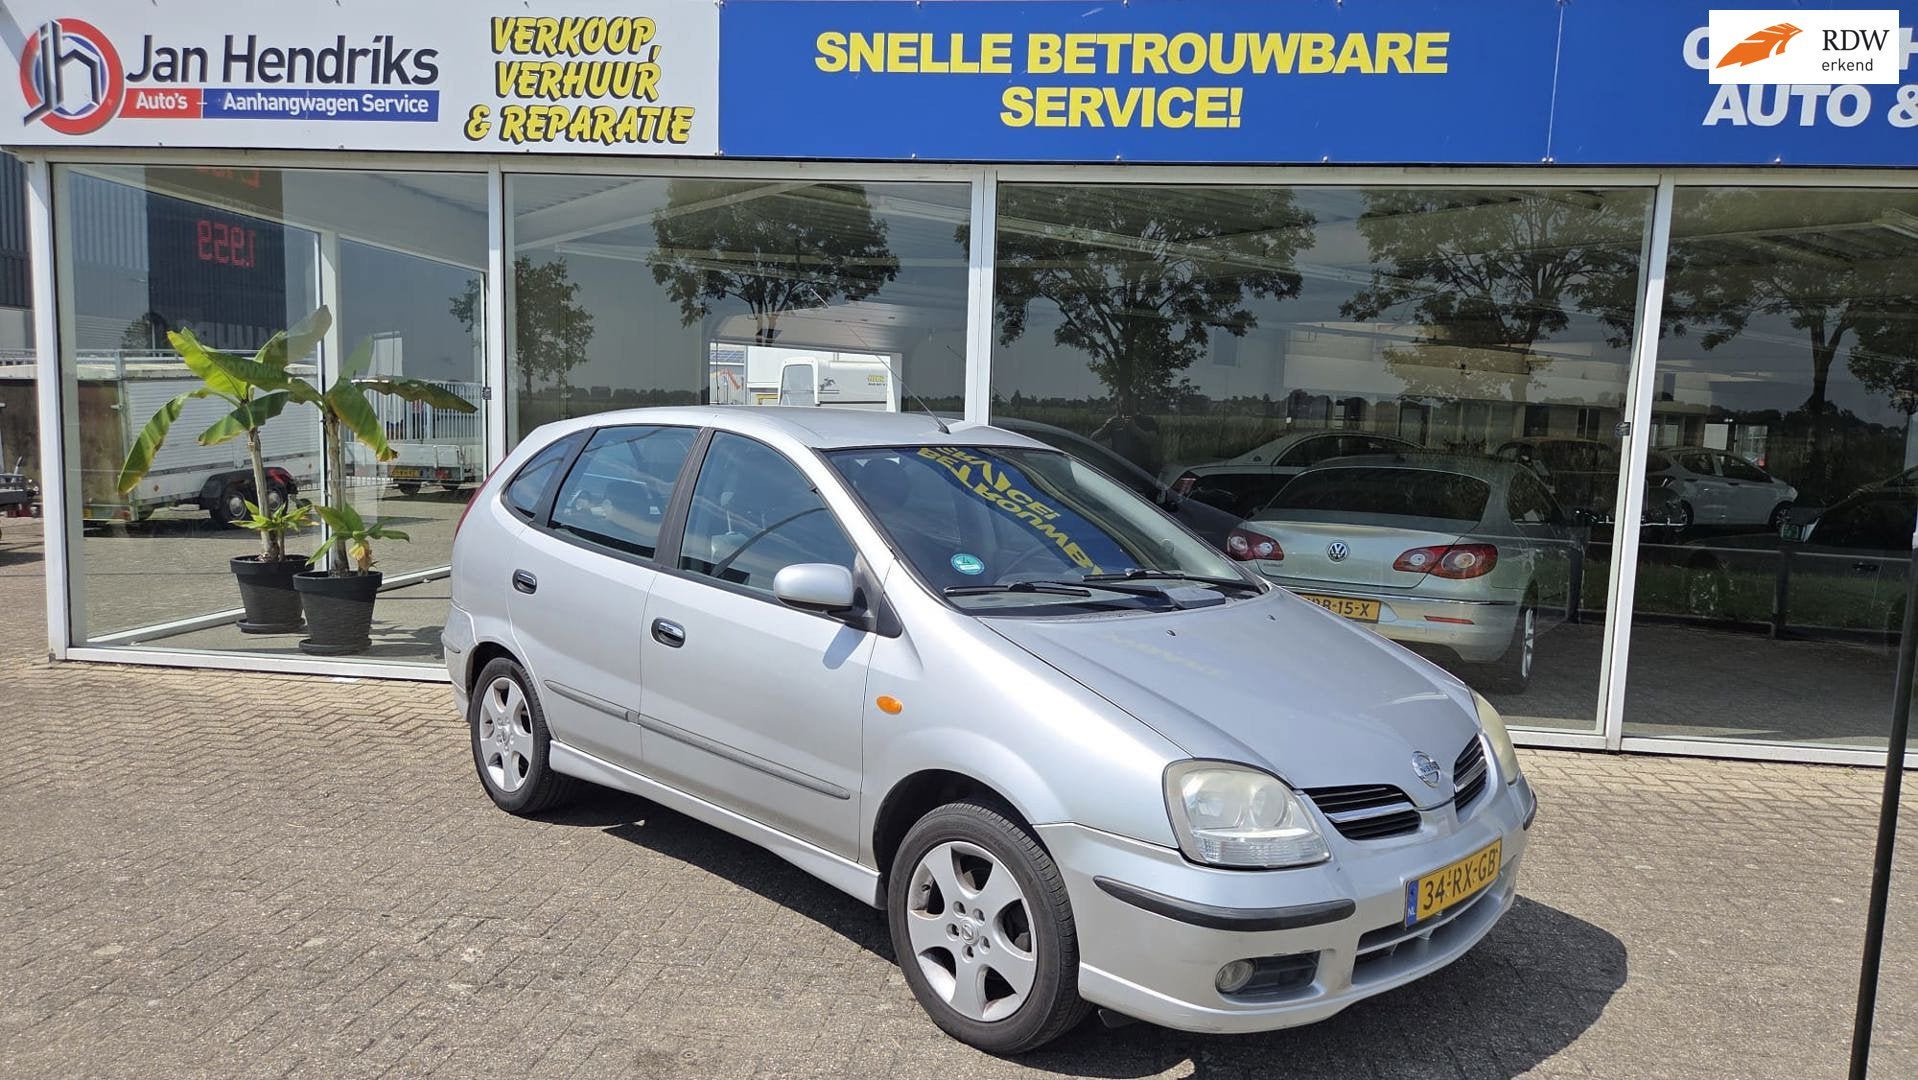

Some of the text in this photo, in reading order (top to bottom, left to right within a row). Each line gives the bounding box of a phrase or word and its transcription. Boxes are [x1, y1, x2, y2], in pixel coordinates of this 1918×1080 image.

[126, 34, 208, 83] Jan
[491, 16, 662, 63] VERKOOP,
[815, 31, 1450, 75] SNELLE BETROUWBARE
[495, 61, 662, 101] VERHUUR
[136, 91, 429, 116] Auto's Aanhangwagen Service
[464, 104, 695, 145] & REPARATIE
[1000, 87, 1243, 129] SERVICE!
[1702, 84, 1872, 127] AUTO
[1423, 848, 1497, 911] 34-RX-GB
